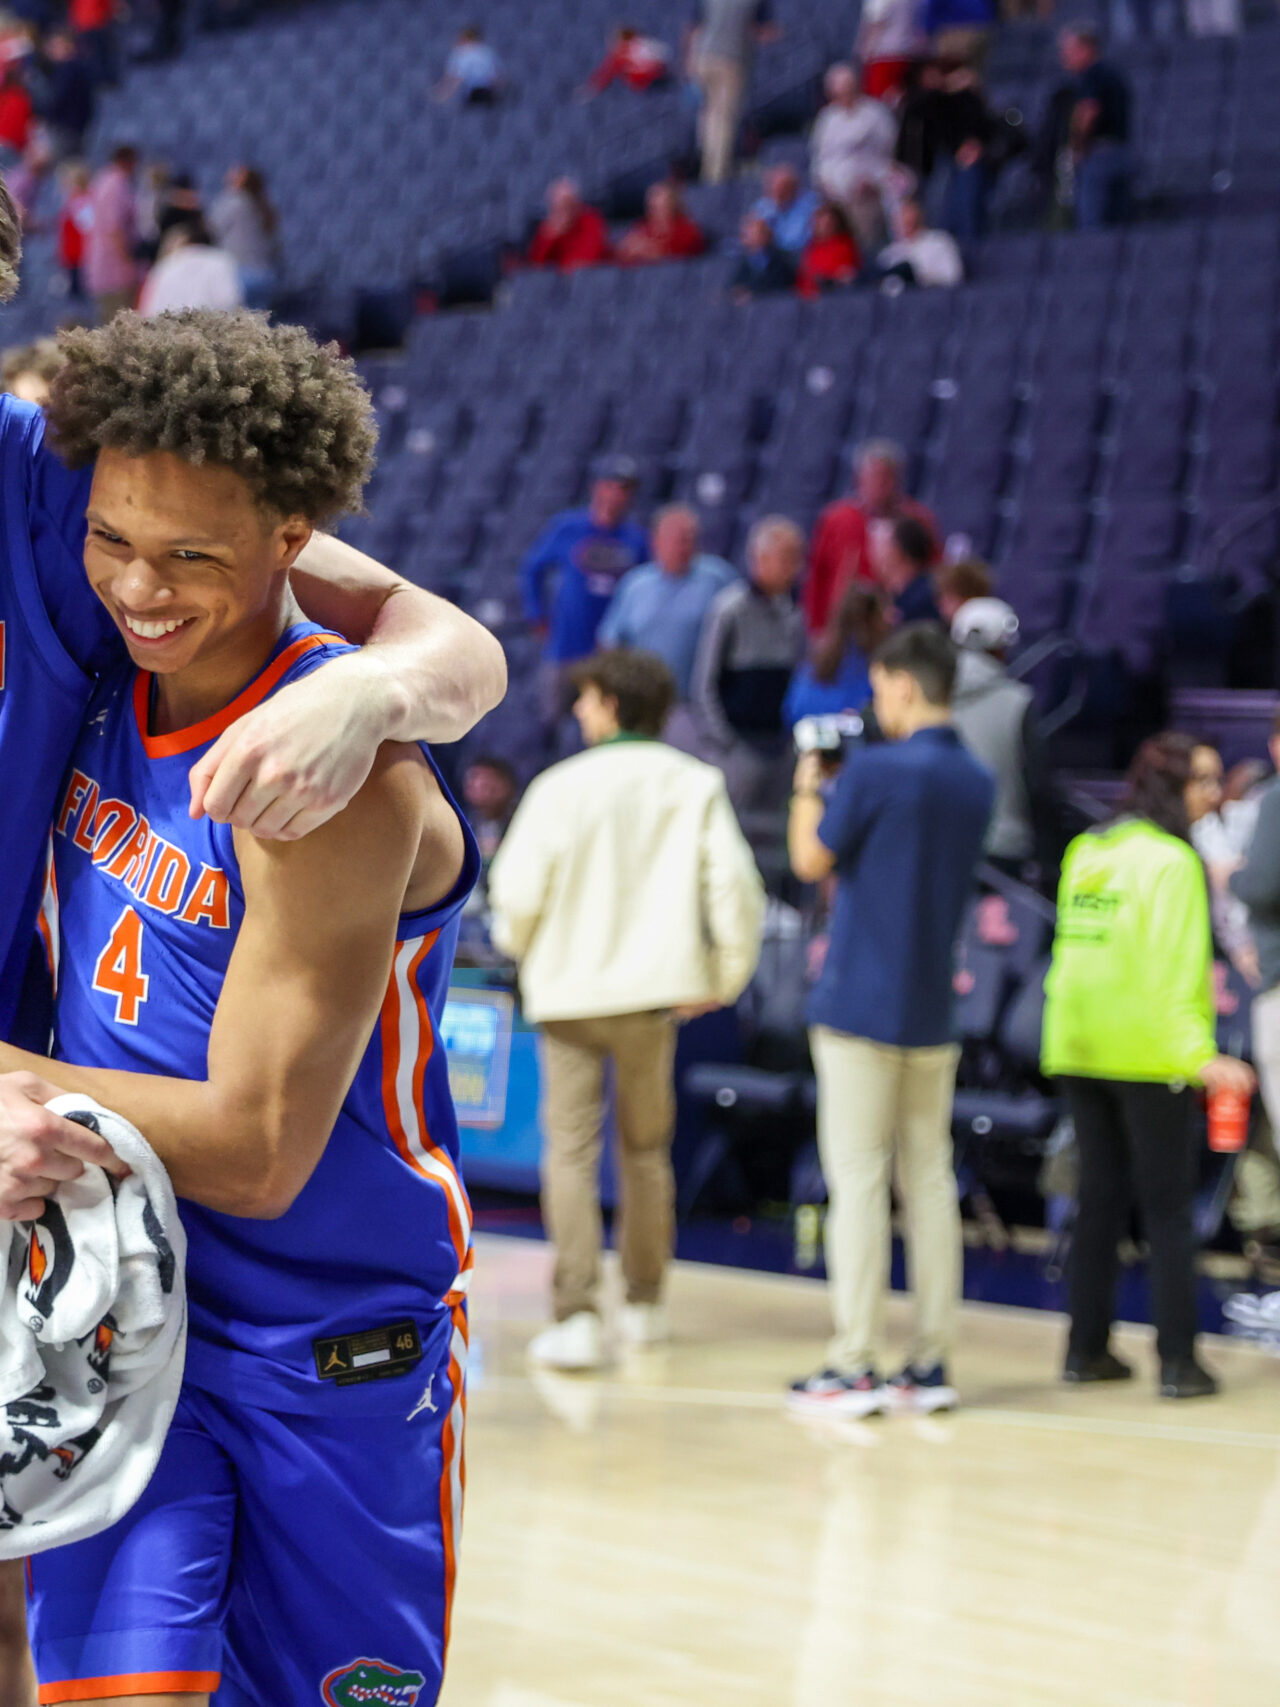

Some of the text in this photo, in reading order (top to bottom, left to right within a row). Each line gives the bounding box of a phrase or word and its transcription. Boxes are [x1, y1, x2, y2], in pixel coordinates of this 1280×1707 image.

[56, 768, 231, 929] FLORIDA
[92, 904, 149, 1026] 4
[396, 1333, 414, 1350] 46
